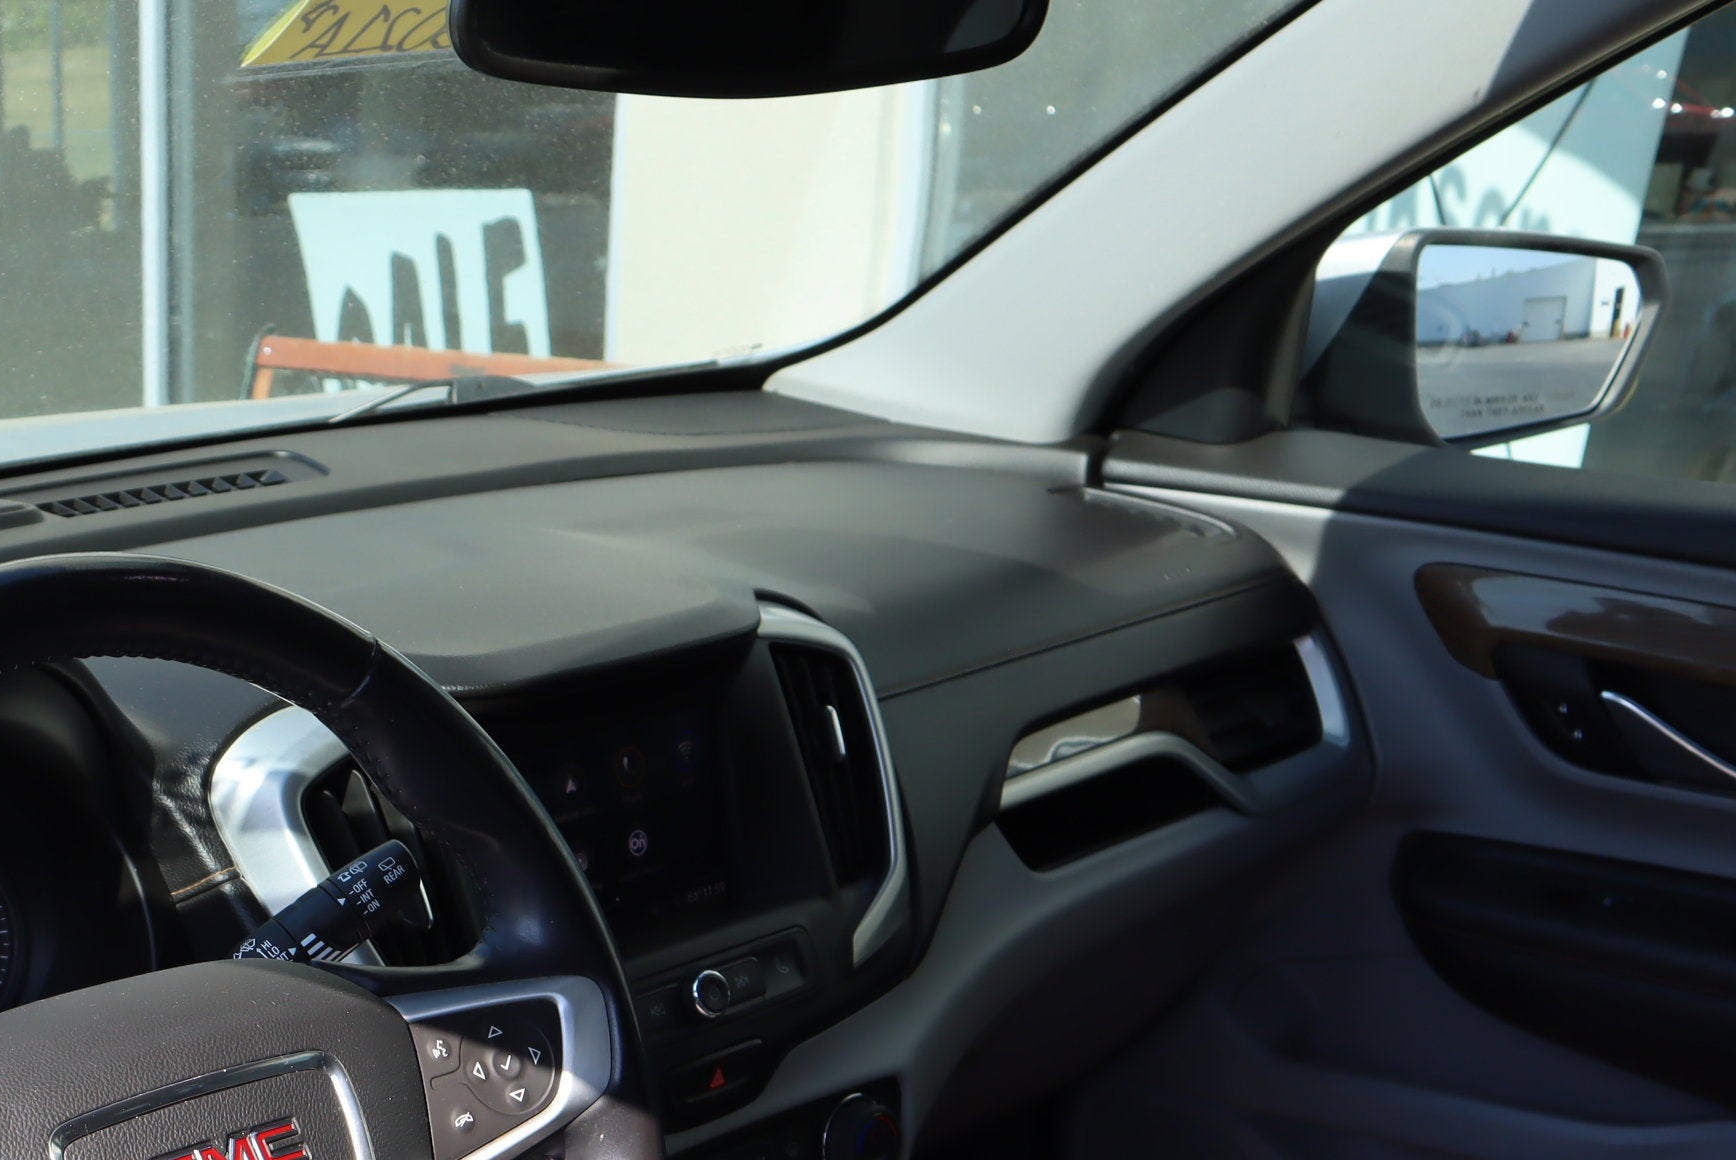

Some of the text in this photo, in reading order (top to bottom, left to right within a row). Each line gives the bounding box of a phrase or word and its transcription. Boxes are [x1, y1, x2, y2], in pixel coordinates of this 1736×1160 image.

[383, 865, 406, 885] REAR
[261, 940, 273, 951] HI
[269, 947, 281, 959] LO
